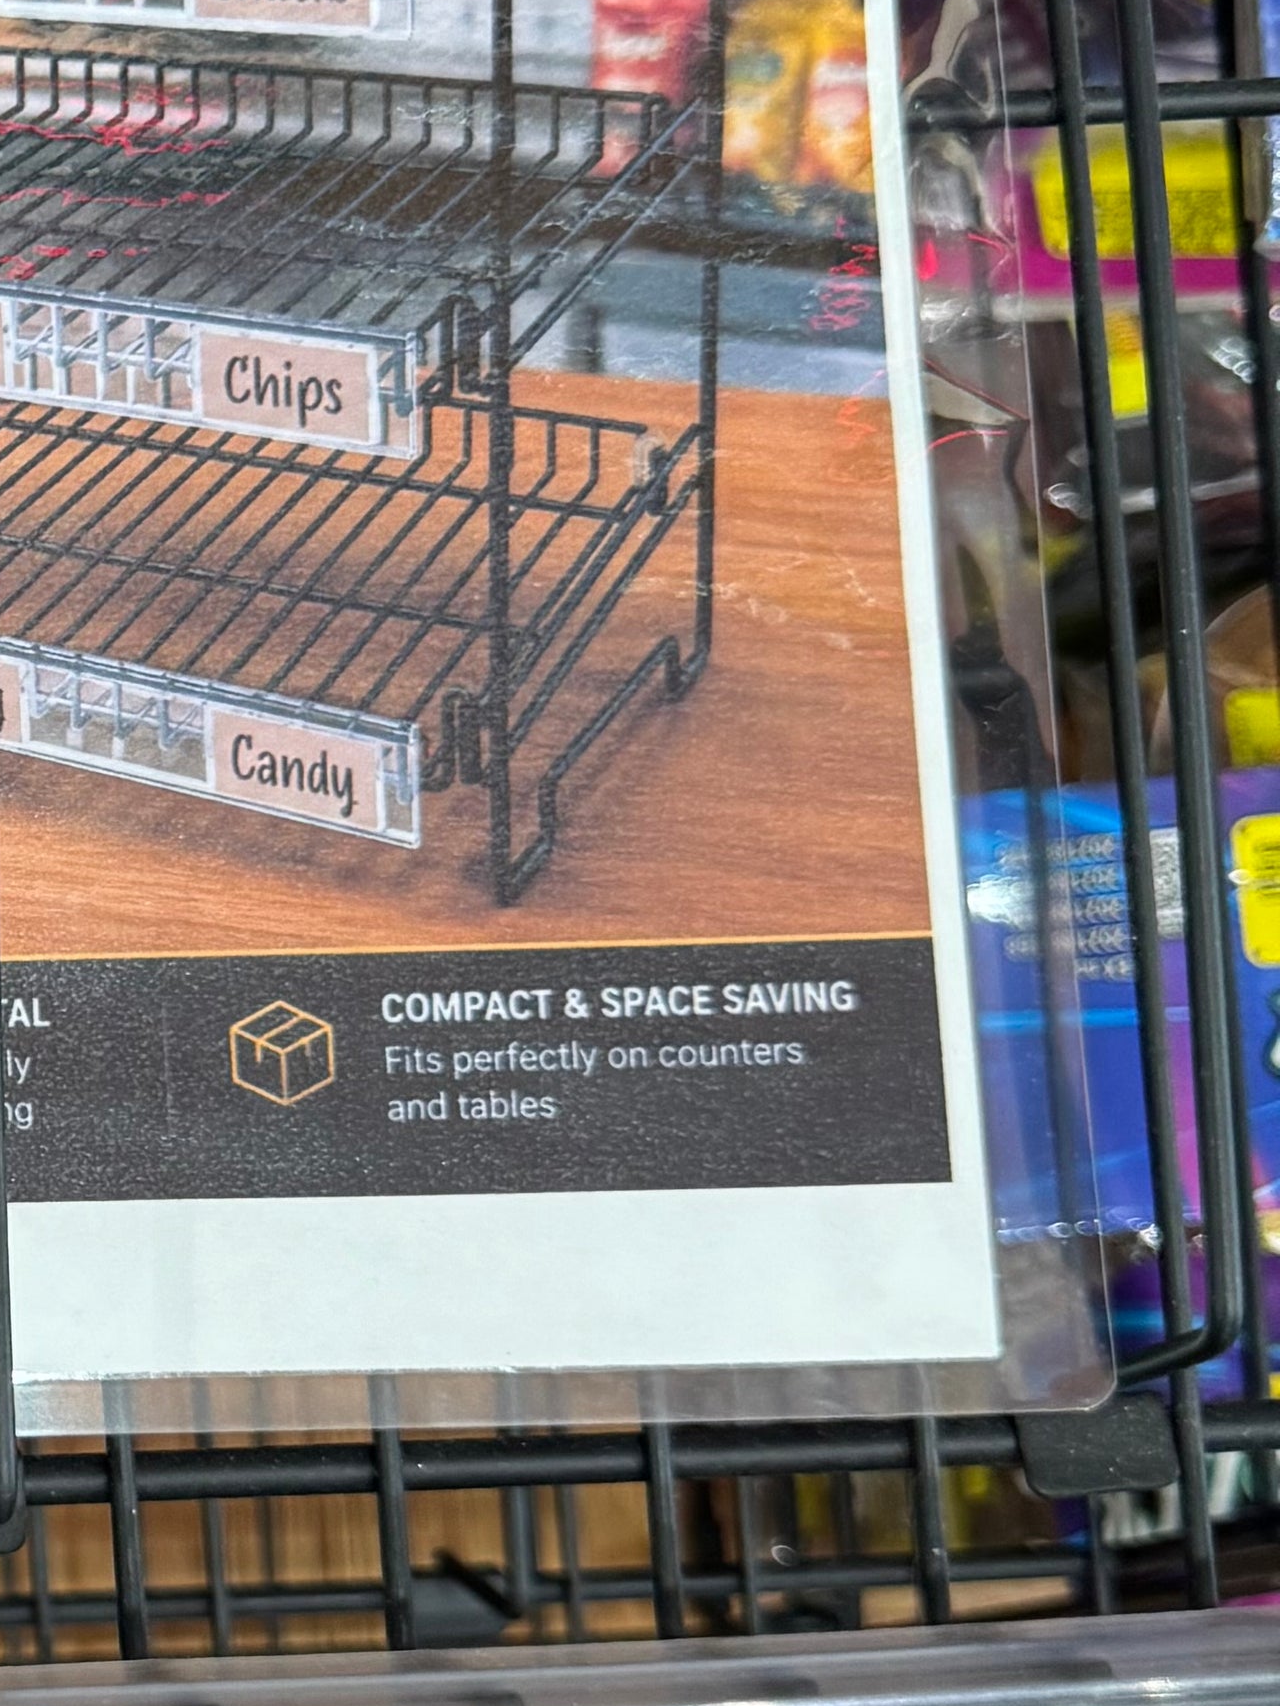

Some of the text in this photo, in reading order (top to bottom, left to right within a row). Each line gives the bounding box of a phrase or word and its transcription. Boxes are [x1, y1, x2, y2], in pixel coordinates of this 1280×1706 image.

[222, 353, 344, 426] Chips
[230, 731, 358, 818] Candy
[381, 980, 857, 1024] COMPACT & SPACE SAVING
[384, 1039, 804, 1081] Fits perfectly on counters
[387, 1091, 559, 1123] and tables
